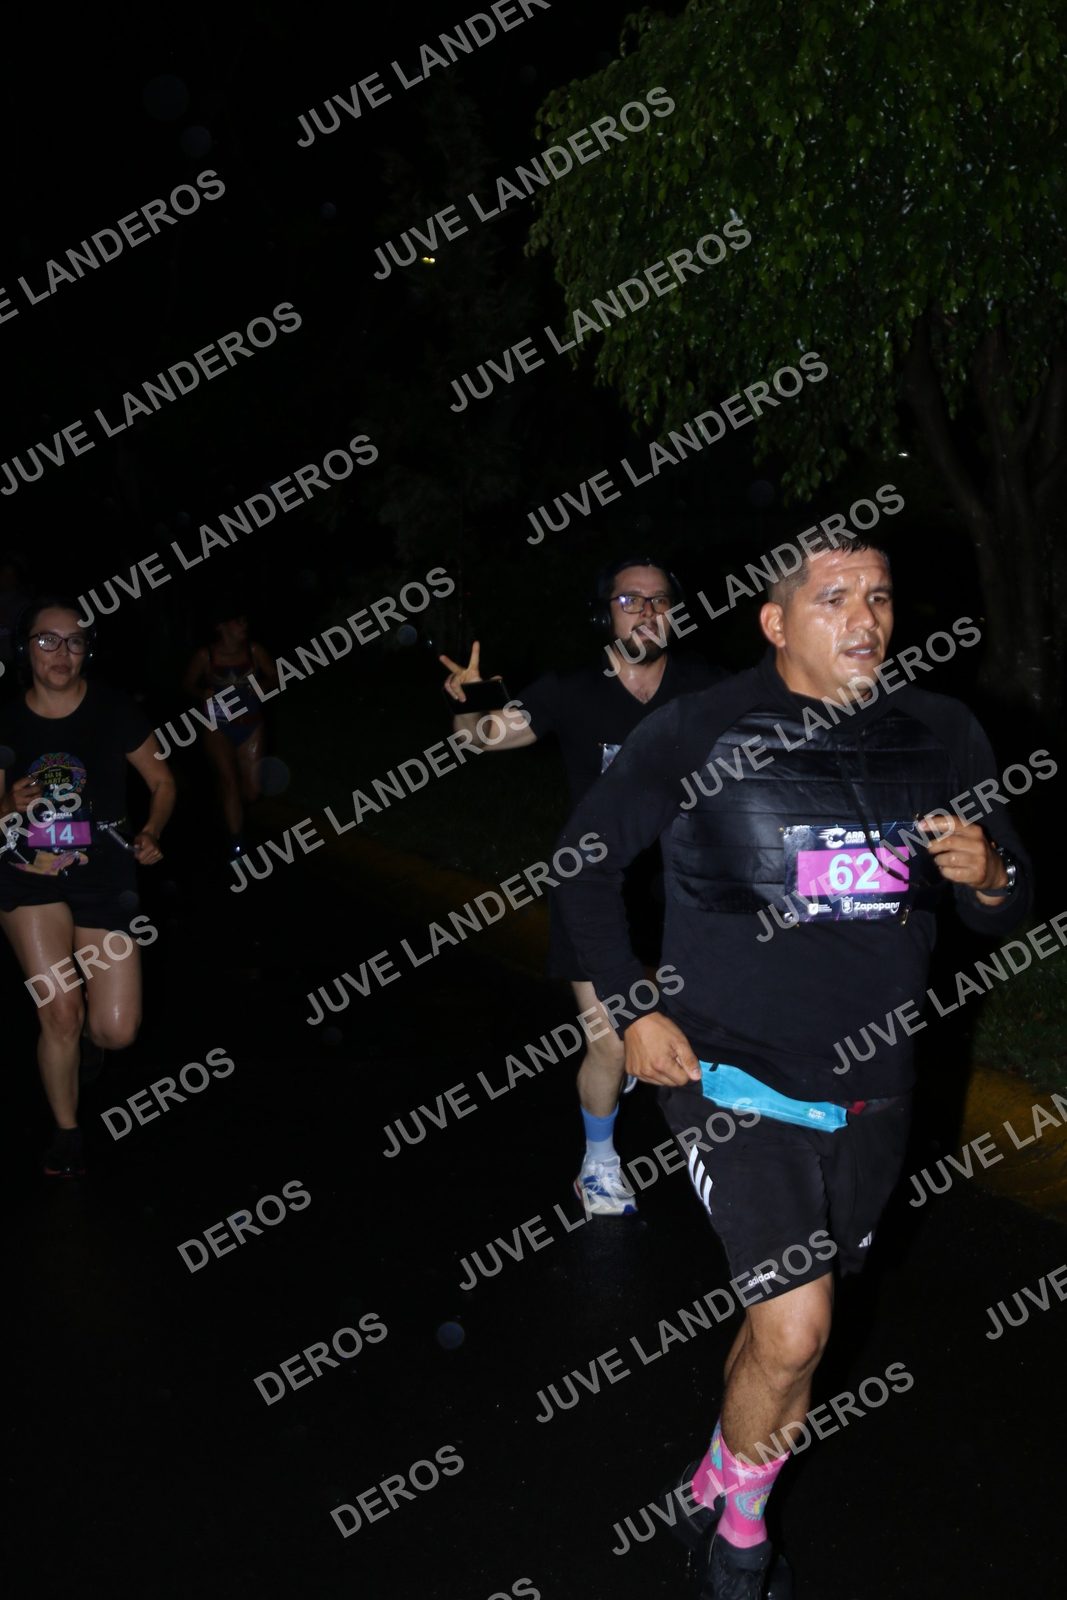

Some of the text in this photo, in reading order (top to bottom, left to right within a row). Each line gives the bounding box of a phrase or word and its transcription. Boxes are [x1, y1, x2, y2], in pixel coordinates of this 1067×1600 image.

[45, 823, 75, 845] 14
[828, 852, 881, 891] 62
[747, 1269, 777, 1287] adidas
